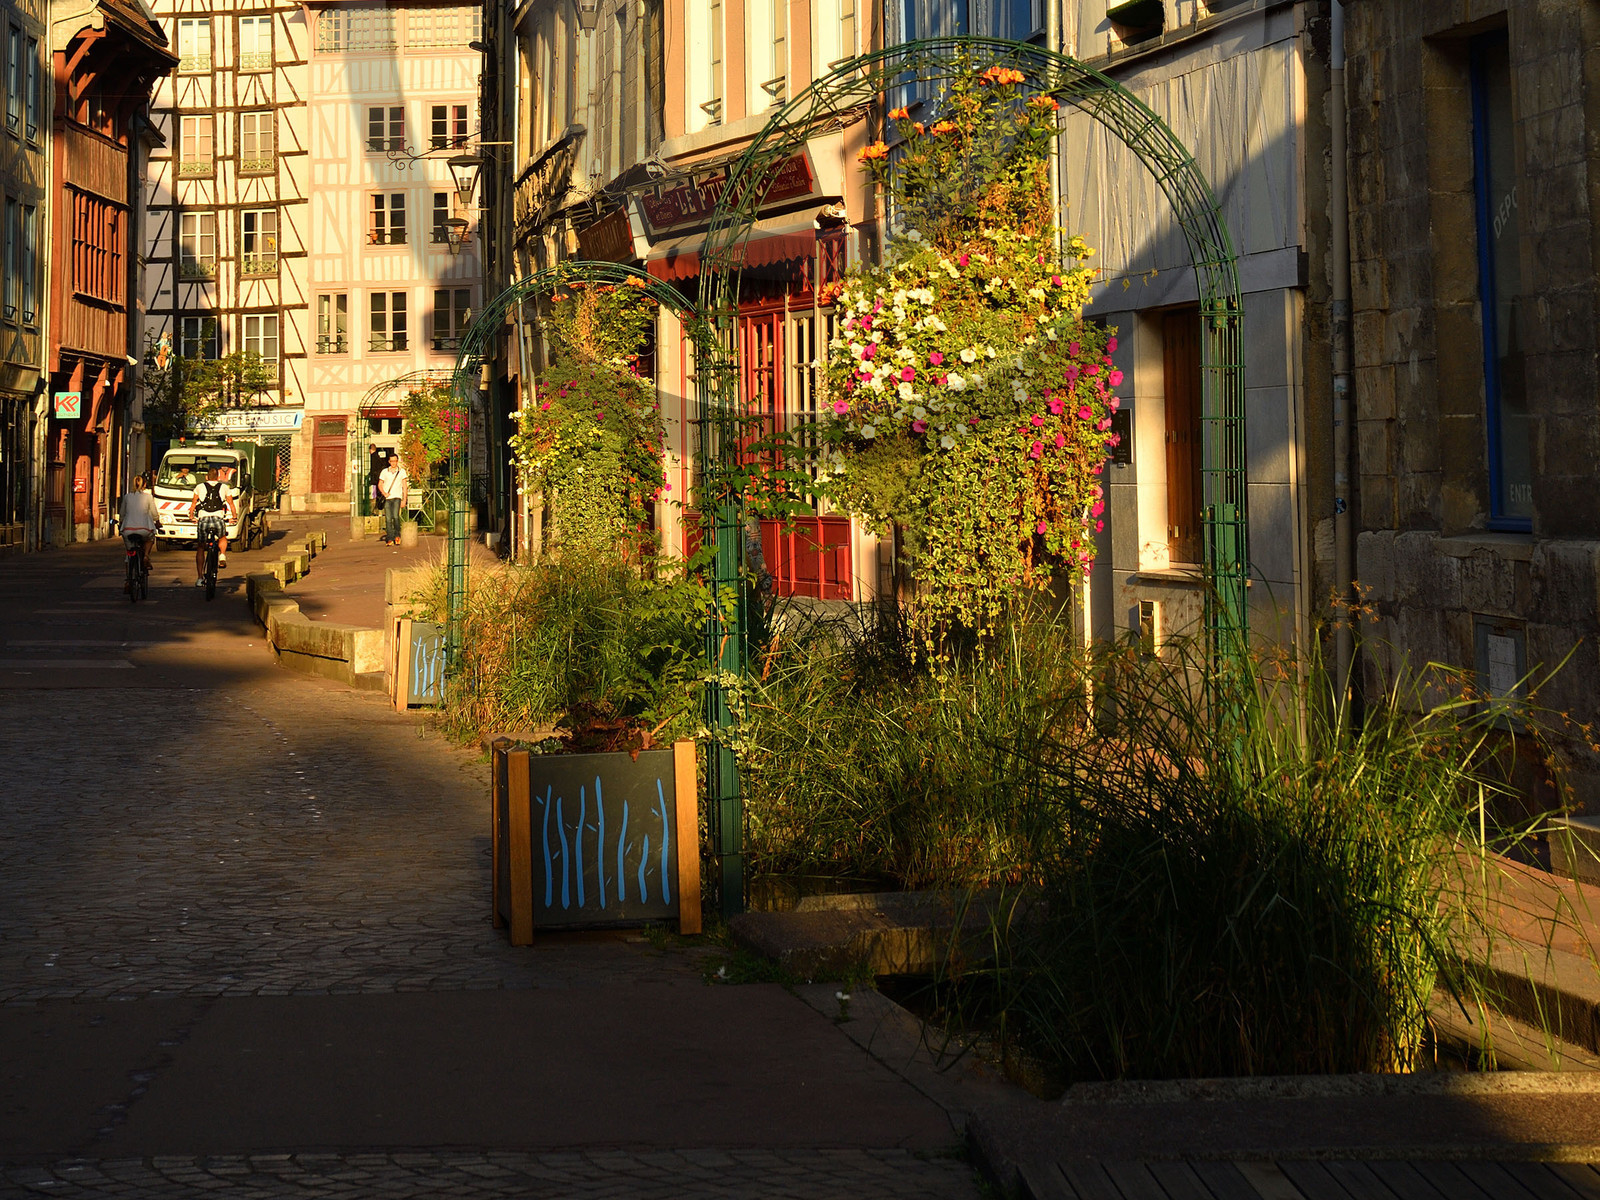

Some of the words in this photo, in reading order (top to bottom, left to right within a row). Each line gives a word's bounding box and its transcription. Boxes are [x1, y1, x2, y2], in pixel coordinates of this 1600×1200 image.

[677, 191, 697, 215] LE
[735, 175, 763, 201] BC
[54, 395, 79, 412] KP
[254, 414, 293, 426] MUSIC
